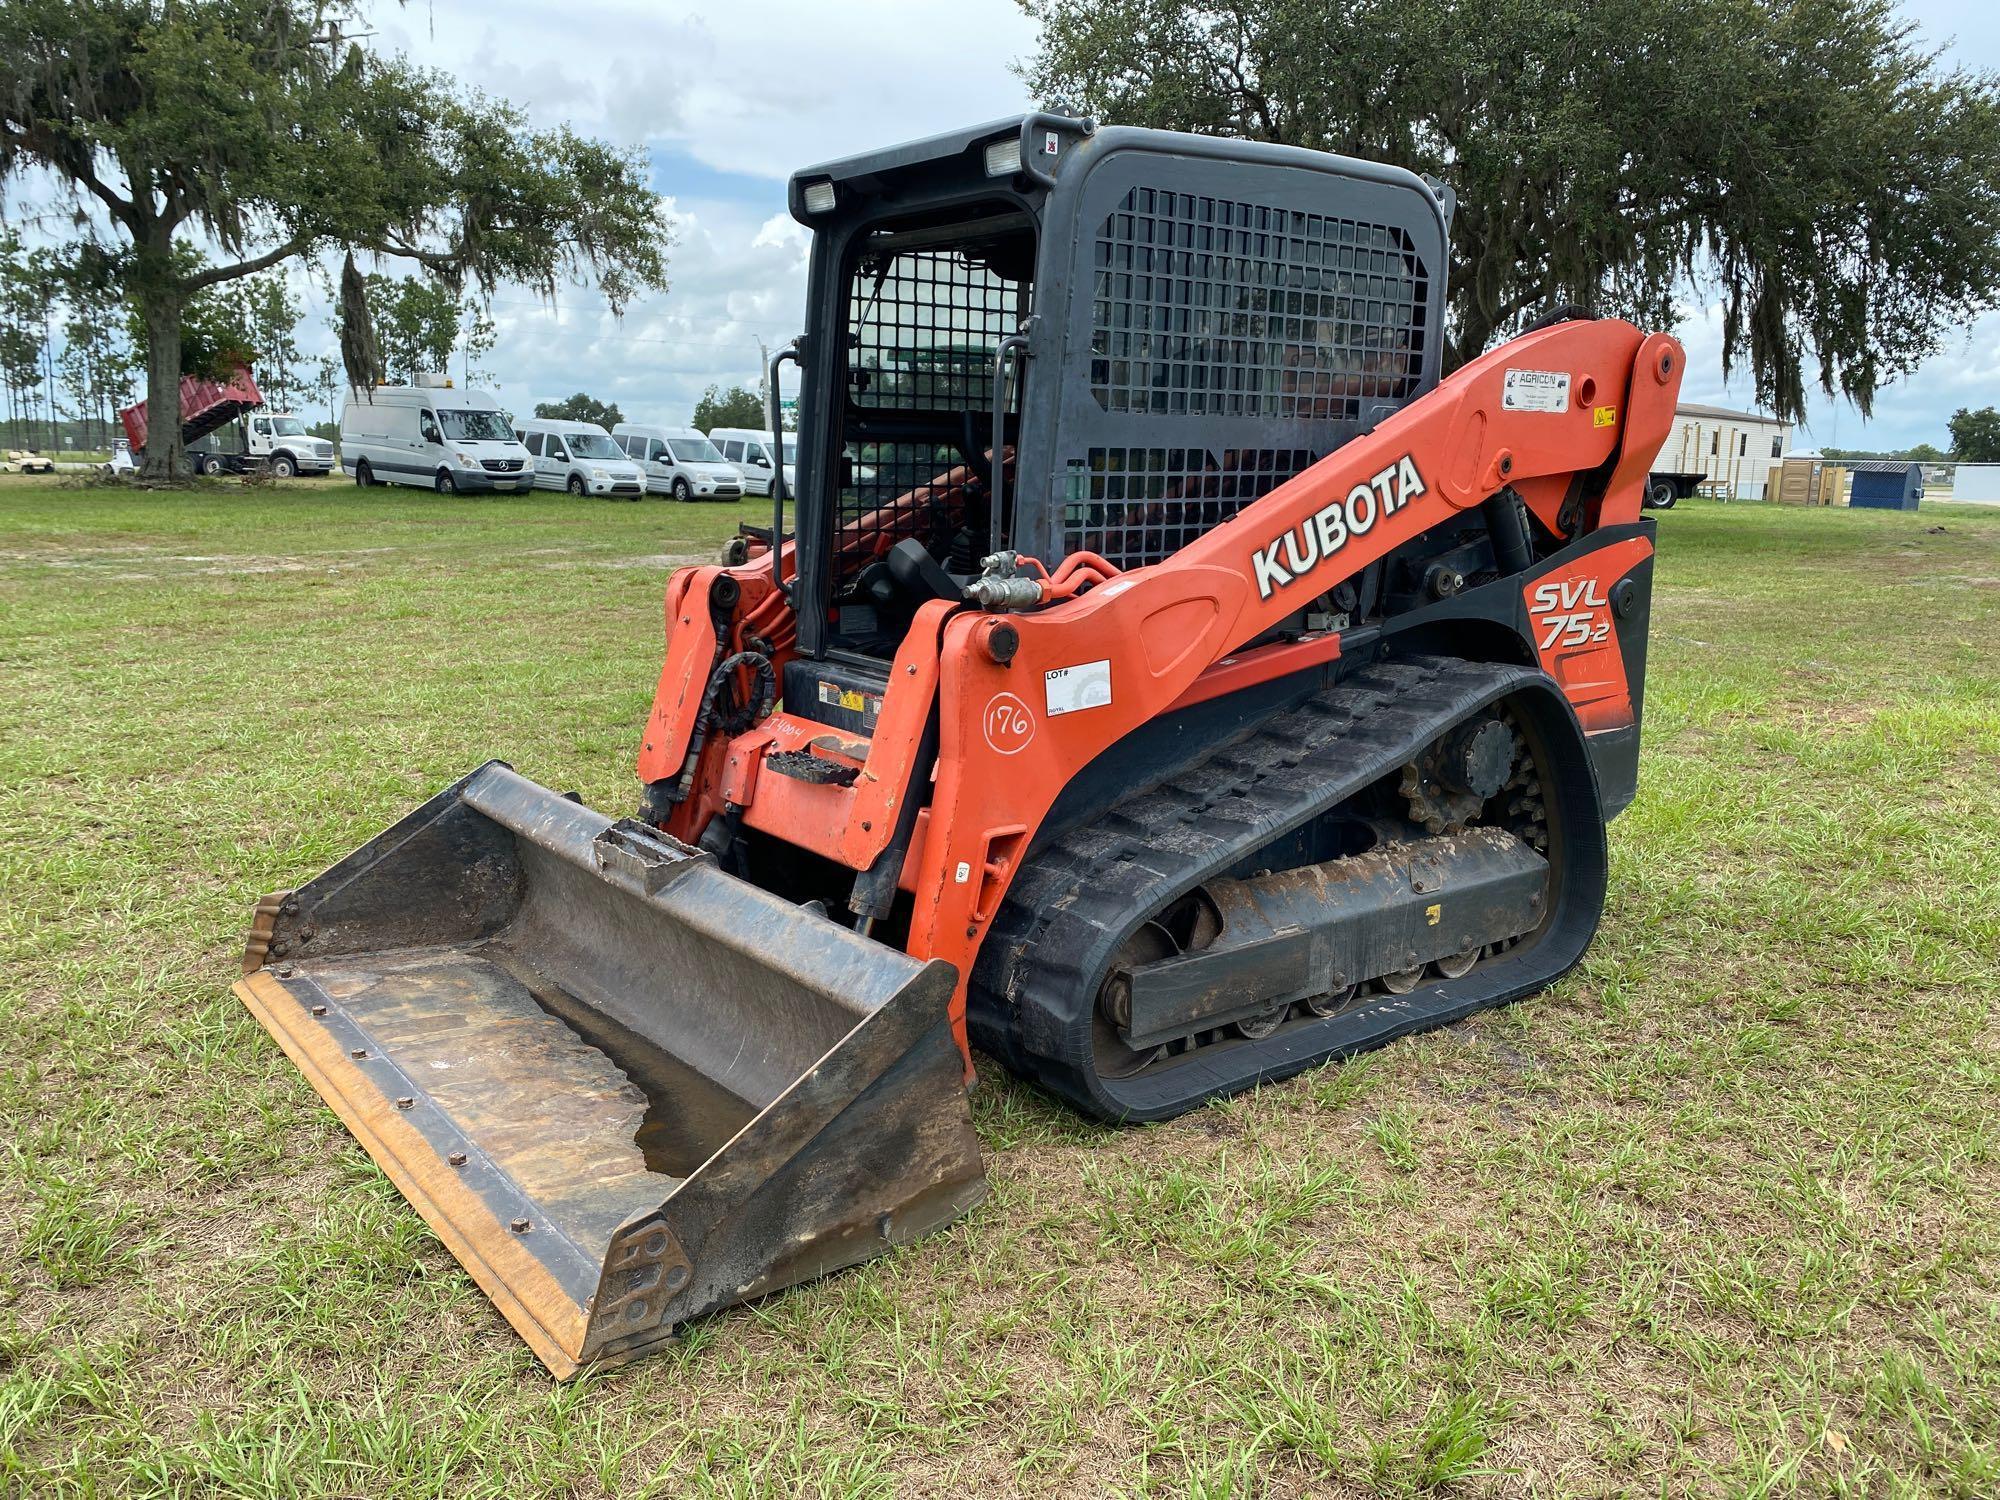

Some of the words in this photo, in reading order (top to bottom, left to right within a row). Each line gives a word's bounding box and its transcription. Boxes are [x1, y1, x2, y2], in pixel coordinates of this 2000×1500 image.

[1519, 373, 1556, 385] AGRICON
[1251, 454, 1427, 600] KUBOTA
[1530, 579, 1607, 614] SVL
[1046, 669, 1069, 680] LOT#
[989, 705, 1028, 736] 176
